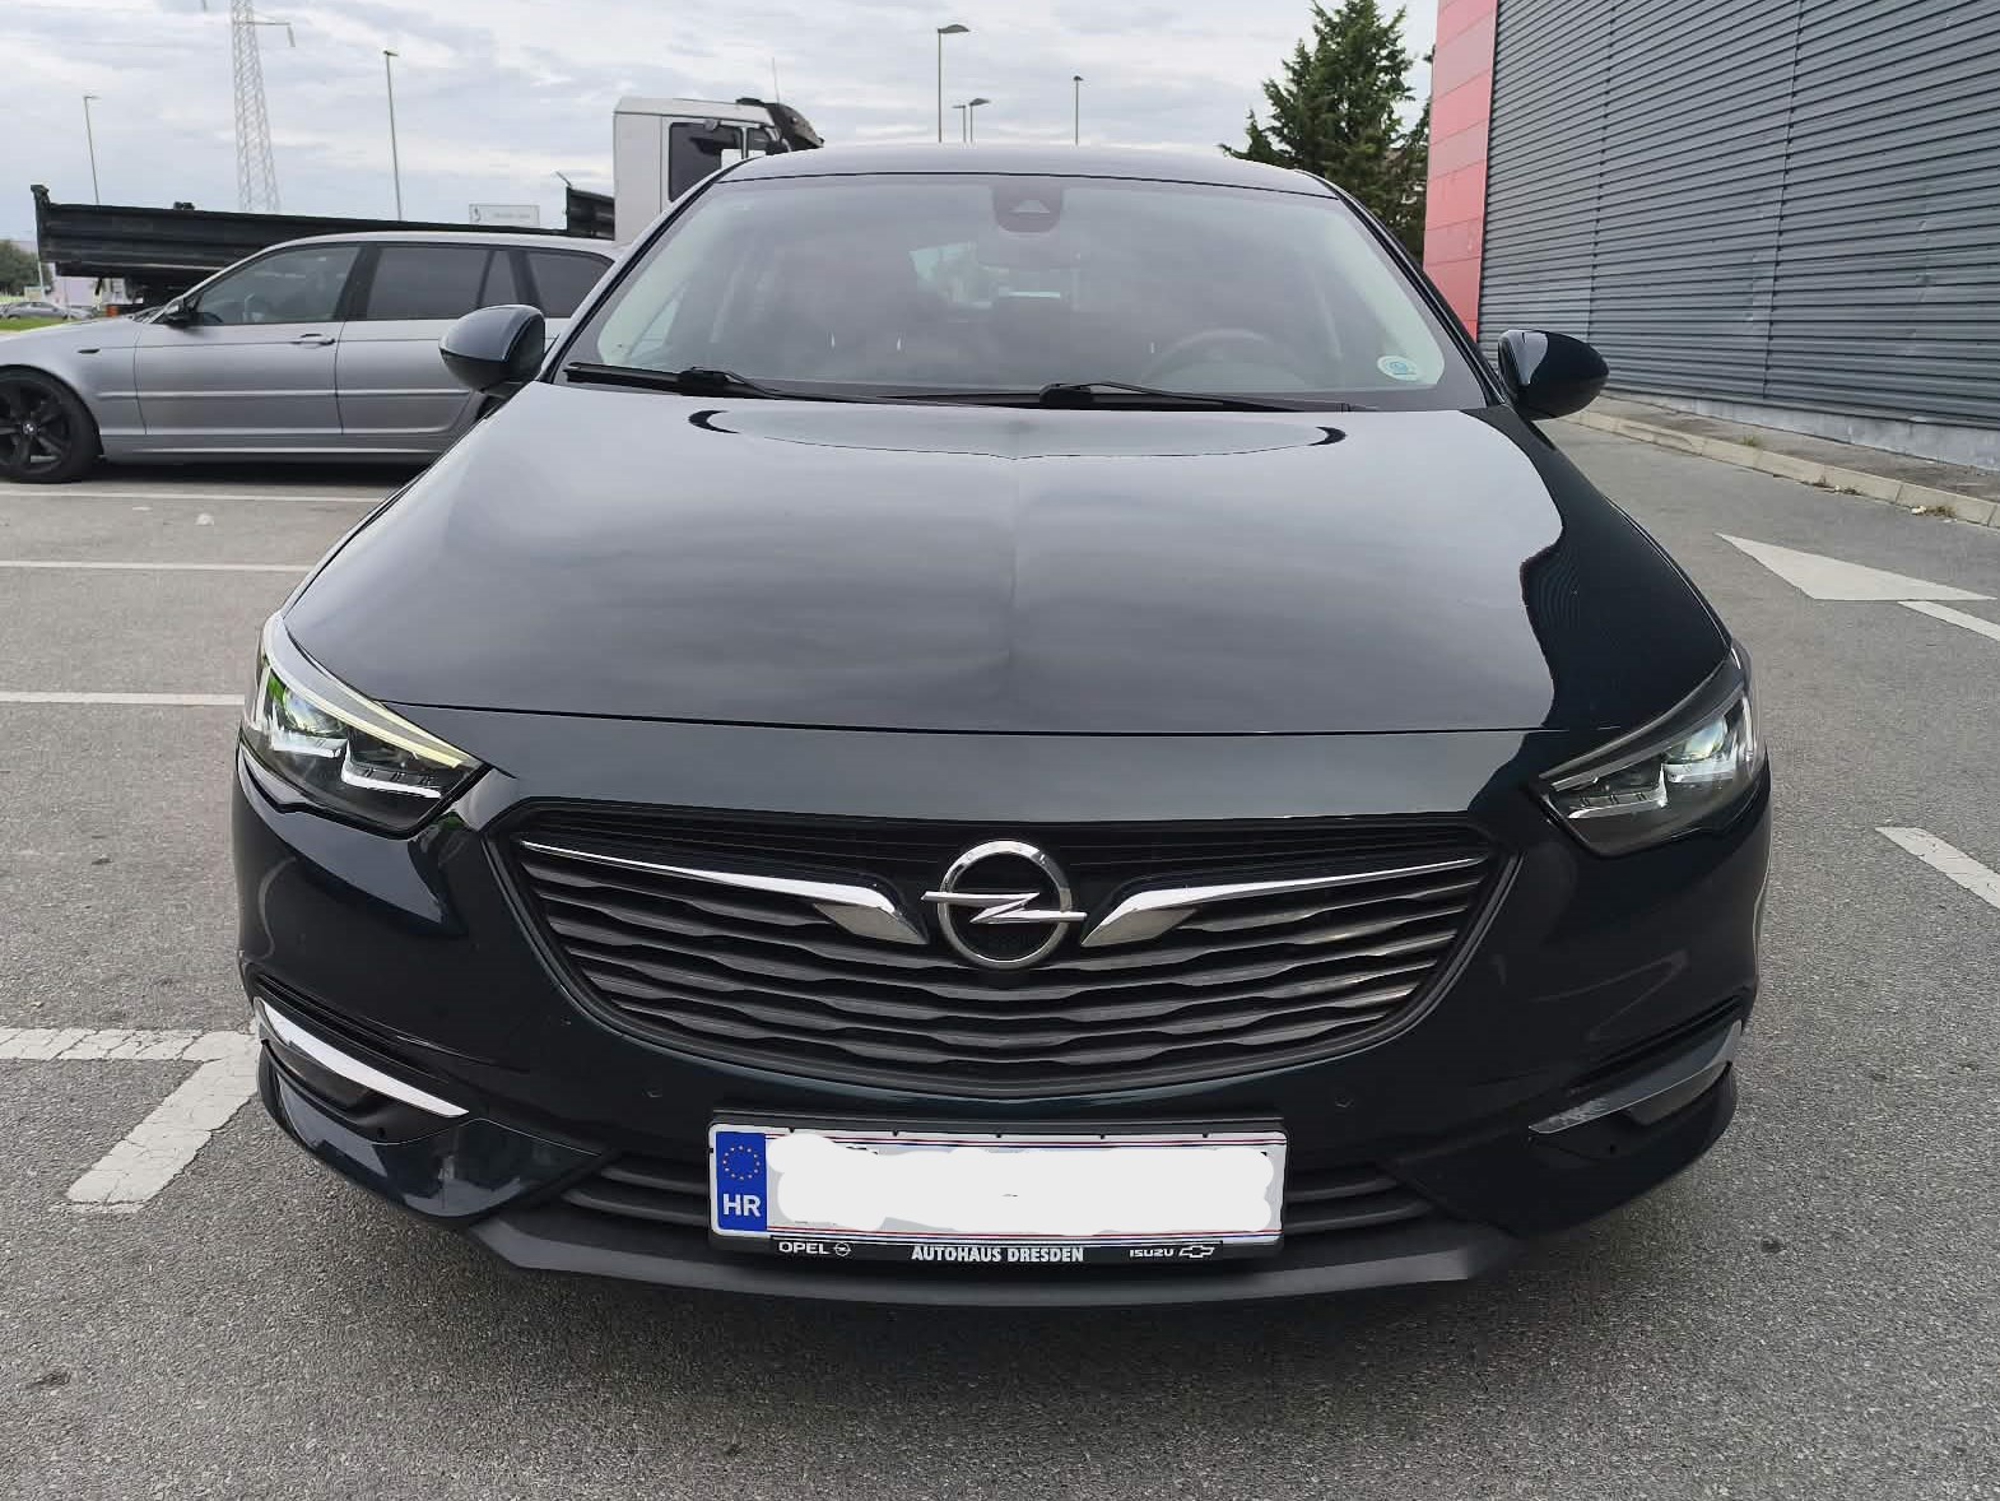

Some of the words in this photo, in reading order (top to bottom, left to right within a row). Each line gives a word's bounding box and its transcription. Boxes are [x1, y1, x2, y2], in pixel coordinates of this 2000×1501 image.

[723, 1193, 761, 1217] HR
[779, 1241, 830, 1254] OPEL
[912, 1245, 1001, 1262] AUTOHAUS
[1007, 1247, 1084, 1262] DRESDEN
[1129, 1248, 1174, 1257] ISUZU
